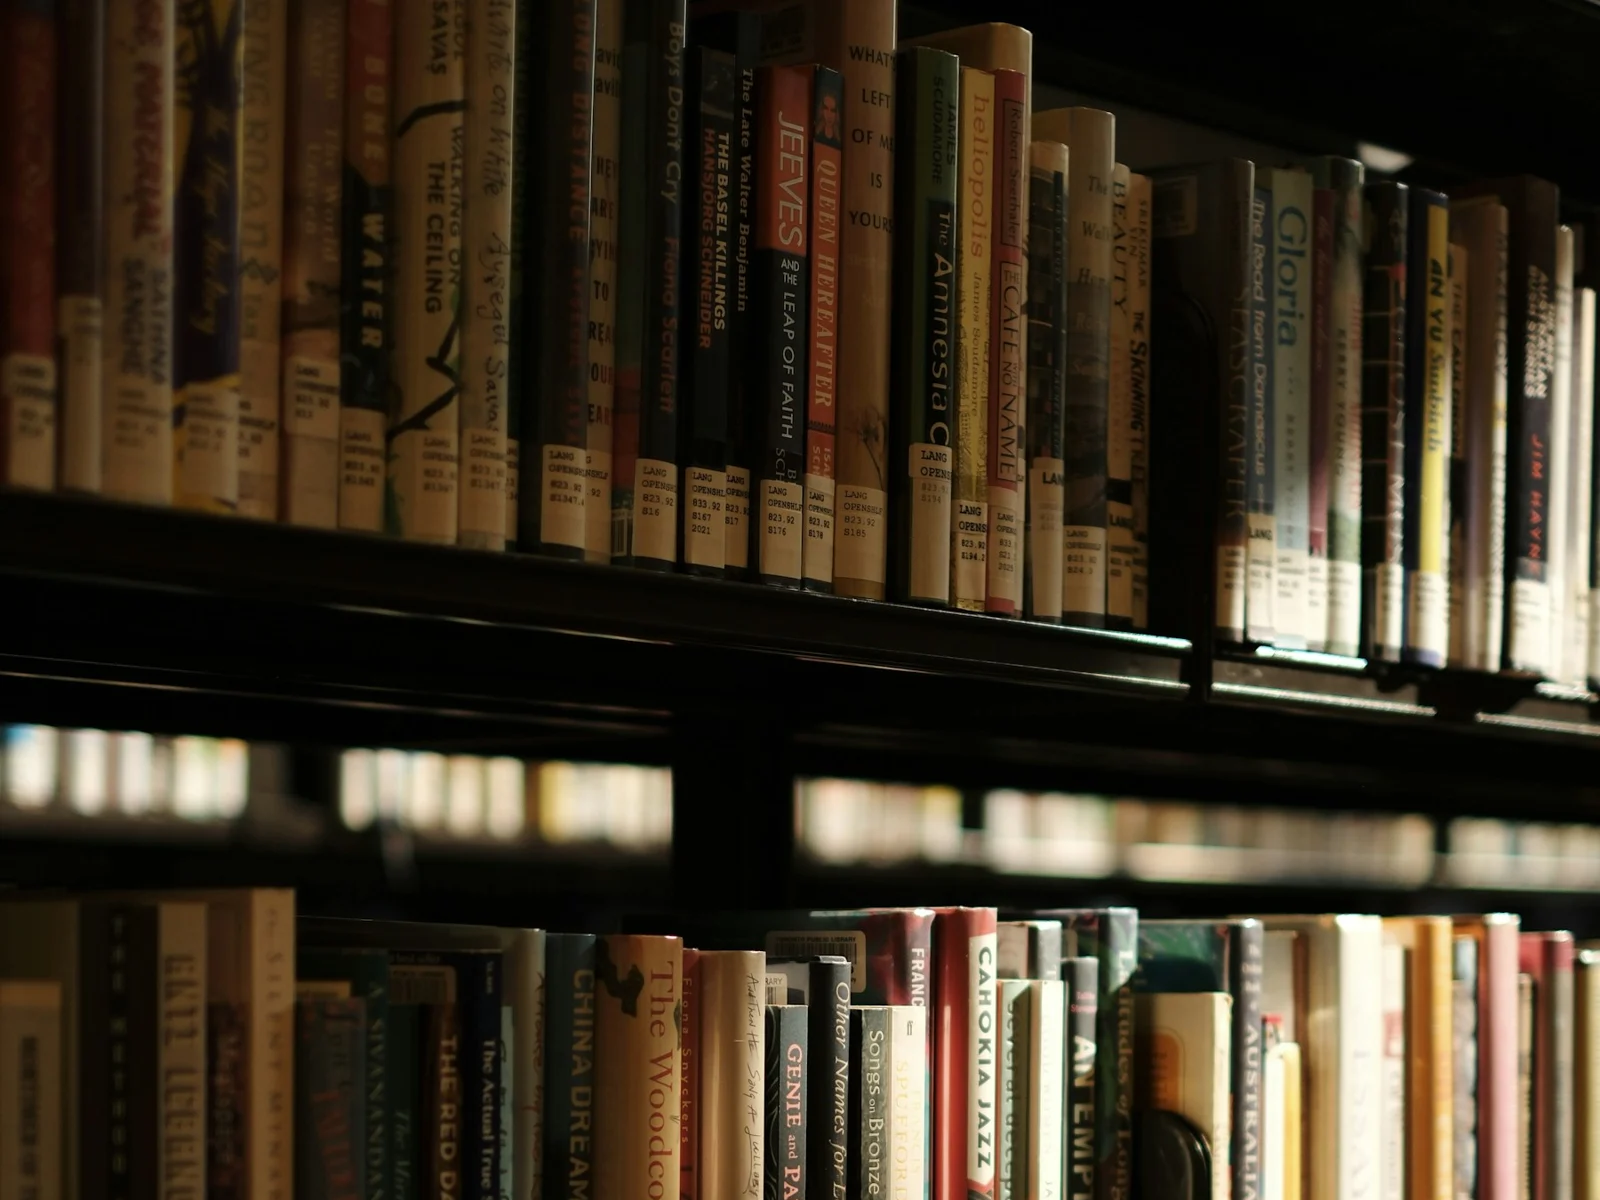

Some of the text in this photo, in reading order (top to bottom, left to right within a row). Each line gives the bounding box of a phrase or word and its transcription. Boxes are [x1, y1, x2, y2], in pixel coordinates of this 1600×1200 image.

[667, 21, 685, 78] Boys
[848, 45, 897, 69] WHAT'S
[363, 57, 384, 160] BONE
[667, 86, 684, 148] Don't
[861, 87, 892, 110] LEFT
[931, 76, 945, 185] SCUDAMORE
[851, 128, 874, 146] OF
[449, 124, 464, 237] WALKING
[661, 161, 682, 206] Cry
[736, 68, 754, 313] The Late Walter Benjamin
[778, 110, 804, 248] JEEVES
[870, 171, 883, 190] IS
[424, 161, 445, 314] THE CEILING
[713, 132, 729, 332] THE BASEL KILLINGS
[848, 210, 894, 235] YOURS
[1112, 181, 1129, 318] BEAUTY
[361, 212, 384, 349] WATER
[661, 236, 681, 307] Fiona
[780, 258, 800, 273] AND
[782, 270, 798, 287] THE
[814, 159, 837, 408] QUEEN HEREAFTER
[968, 93, 990, 417] heliopolis Scudamore
[1276, 204, 1309, 349] Gloria
[930, 211, 953, 412] The Amnesia
[1251, 199, 1269, 477] The Road from Damascus
[781, 290, 797, 440] LEAP OF FAITH
[1129, 339, 1148, 432] SKINNING
[1000, 361, 1017, 475] NO NAME
[692, 471, 713, 483] LANG
[1528, 434, 1544, 481] JIM
[642, 493, 675, 508] 823.92
[692, 498, 722, 512] 833.92
[768, 485, 788, 497] LANG
[808, 517, 831, 529] 823.92
[844, 489, 869, 501] LANG
[959, 503, 983, 517] LANG
[691, 523, 711, 535] 2021
[843, 527, 868, 539] S185
[570, 967, 595, 1078] CHINA
[650, 960, 674, 1040] The
[834, 980, 851, 1050] Other
[440, 1035, 459, 1094] THE
[482, 1039, 498, 1076] The
[680, 976, 693, 1145] Fiona Snyckers
[786, 1042, 803, 1129] GENIE
[866, 1029, 885, 1096] Songs
[977, 946, 993, 1169] CAHOKIA JAZZ
[1073, 1035, 1097, 1088] AN
[481, 1077, 498, 1143] Actual
[832, 1054, 850, 1137] Names
[868, 1098, 876, 1115] on
[439, 1104, 458, 1161] RED
[787, 1134, 799, 1160] and
[828, 1138, 848, 1177] for
[867, 1117, 885, 1197] Bronze
[480, 1147, 497, 1190] True
